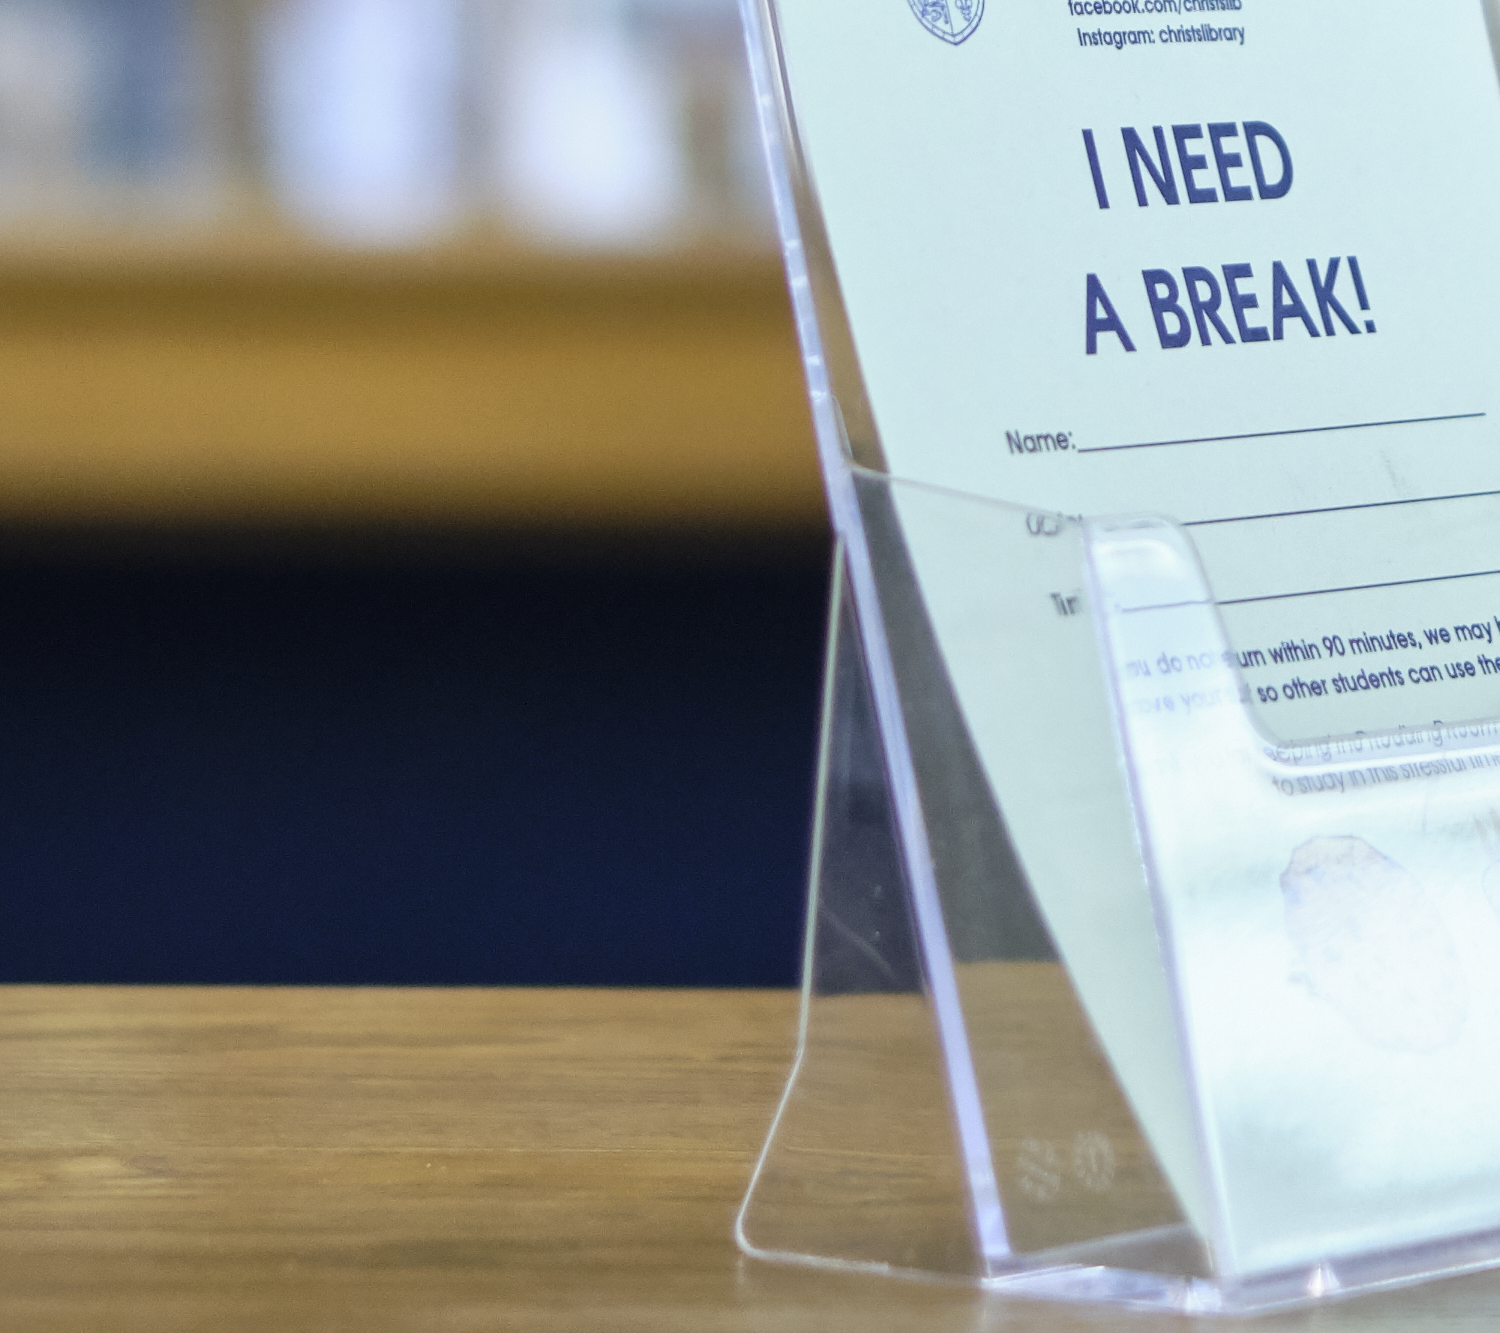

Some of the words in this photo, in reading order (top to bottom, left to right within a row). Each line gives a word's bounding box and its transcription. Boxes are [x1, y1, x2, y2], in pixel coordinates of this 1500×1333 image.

[1076, 26, 1156, 50] Instagram:
[1158, 23, 1245, 47] christslibrary
[1081, 128, 1110, 209] I
[1120, 120, 1294, 208] NEED
[1085, 272, 1137, 355] A
[1141, 255, 1377, 350] BREAK!
[1005, 429, 1077, 454] Name:
[1268, 639, 1322, 665] within
[1322, 634, 1346, 658] 90
[1348, 628, 1423, 656] minutes,
[1423, 625, 1451, 646] we
[1453, 619, 1492, 644] may
[1257, 684, 1279, 703] so
[1282, 675, 1330, 700] other
[1331, 665, 1405, 695] students
[1407, 664, 1444, 685] can
[1443, 659, 1476, 679] use
